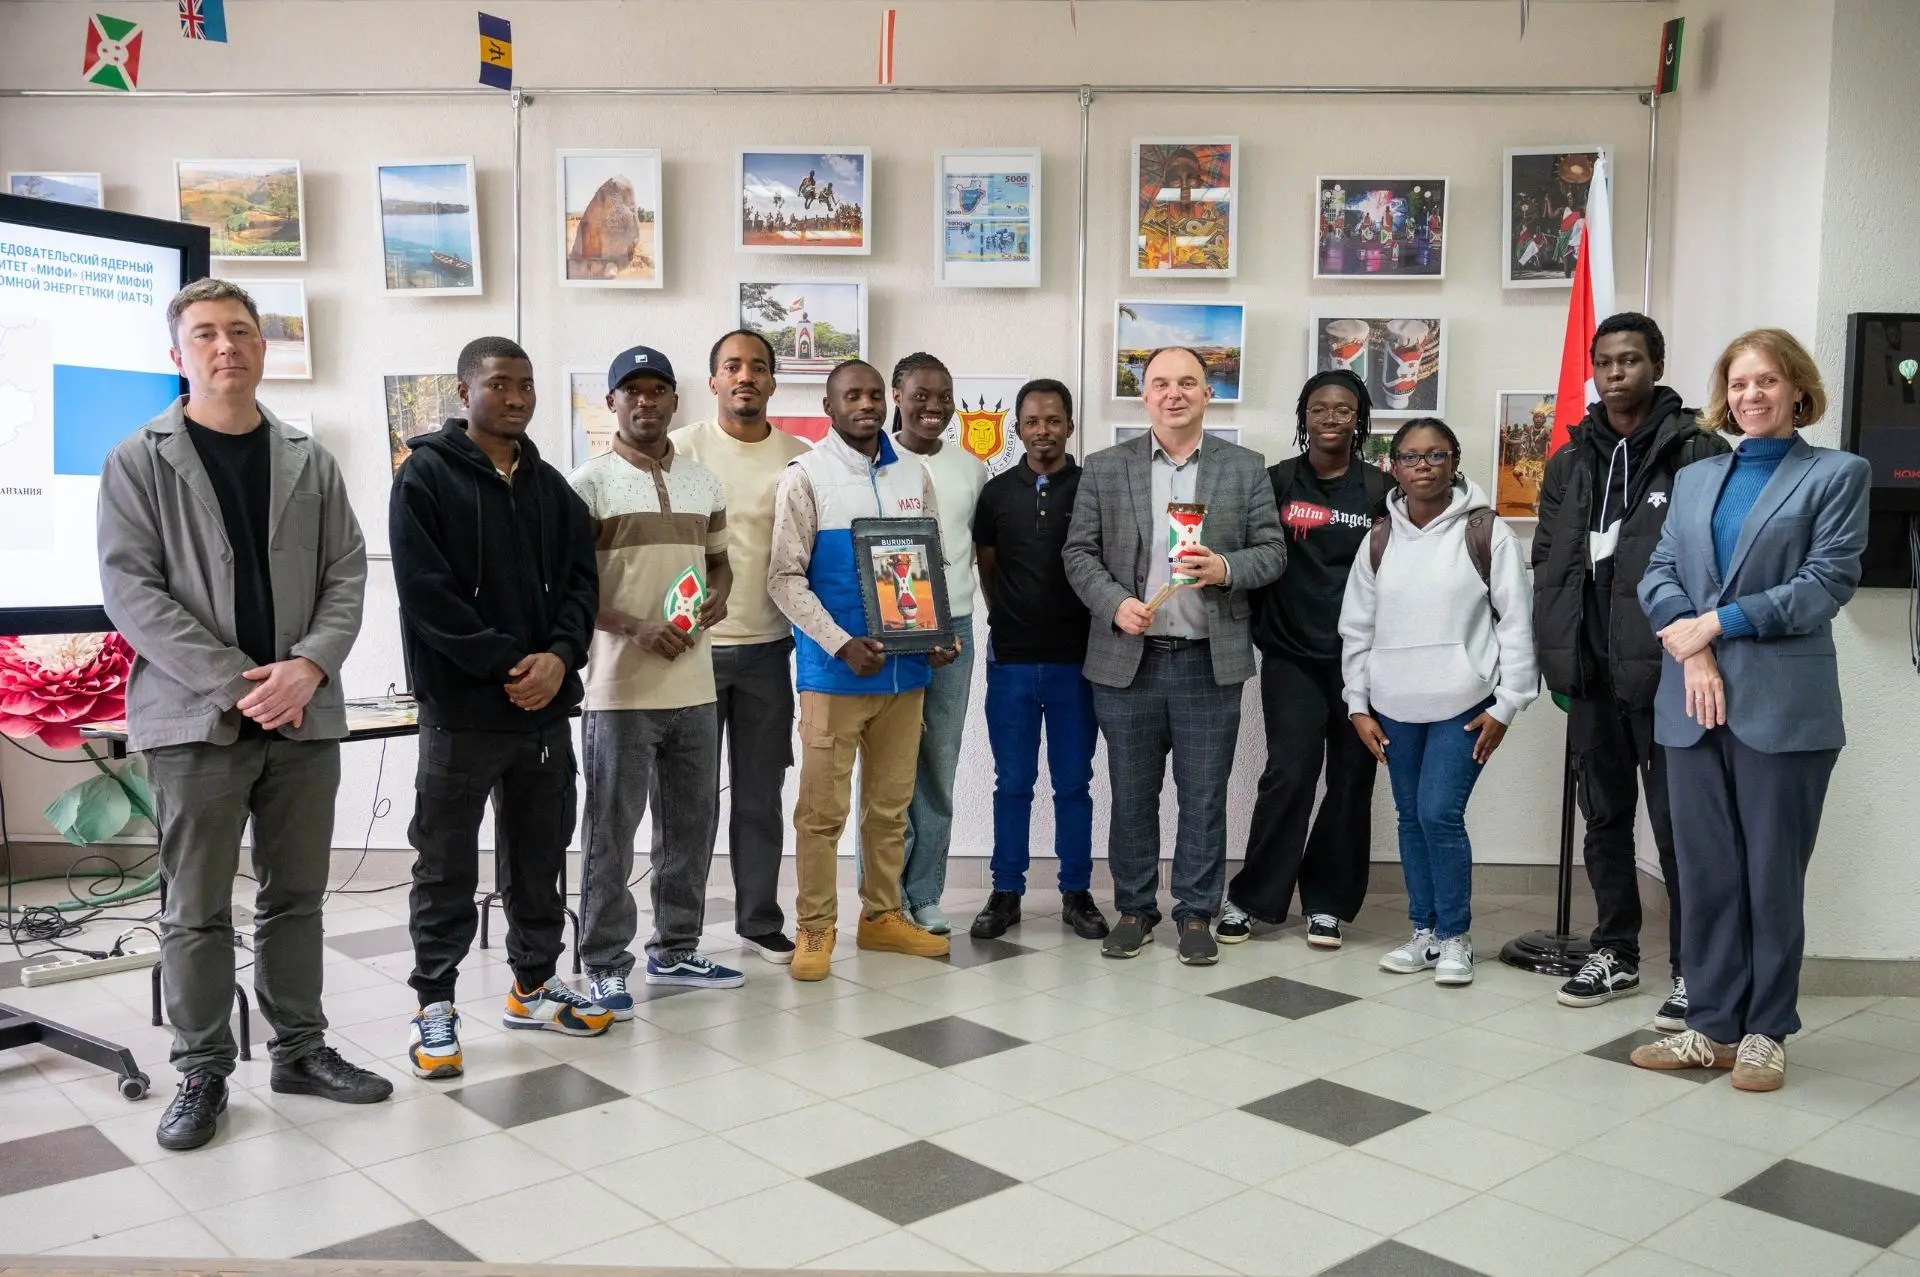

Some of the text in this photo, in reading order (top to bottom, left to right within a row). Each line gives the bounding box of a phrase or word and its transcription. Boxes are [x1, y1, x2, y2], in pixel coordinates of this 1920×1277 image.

[1005, 175, 1028, 183] 5000
[0, 242, 154, 274] ЕДОВАТЕЛЬСКИЙ ЯДЕРНЫЙ
[31, 263, 77, 279] «МИФИ»
[81, 269, 114, 284] (НИЯУ
[116, 275, 153, 291] МИФИ)
[43, 280, 114, 300] ЭНЕРГЕТИКИ
[117, 290, 153, 306] (ИАТЭ)
[1287, 504, 1373, 529] Palm Angels
[881, 538, 914, 546] BURUNDI
